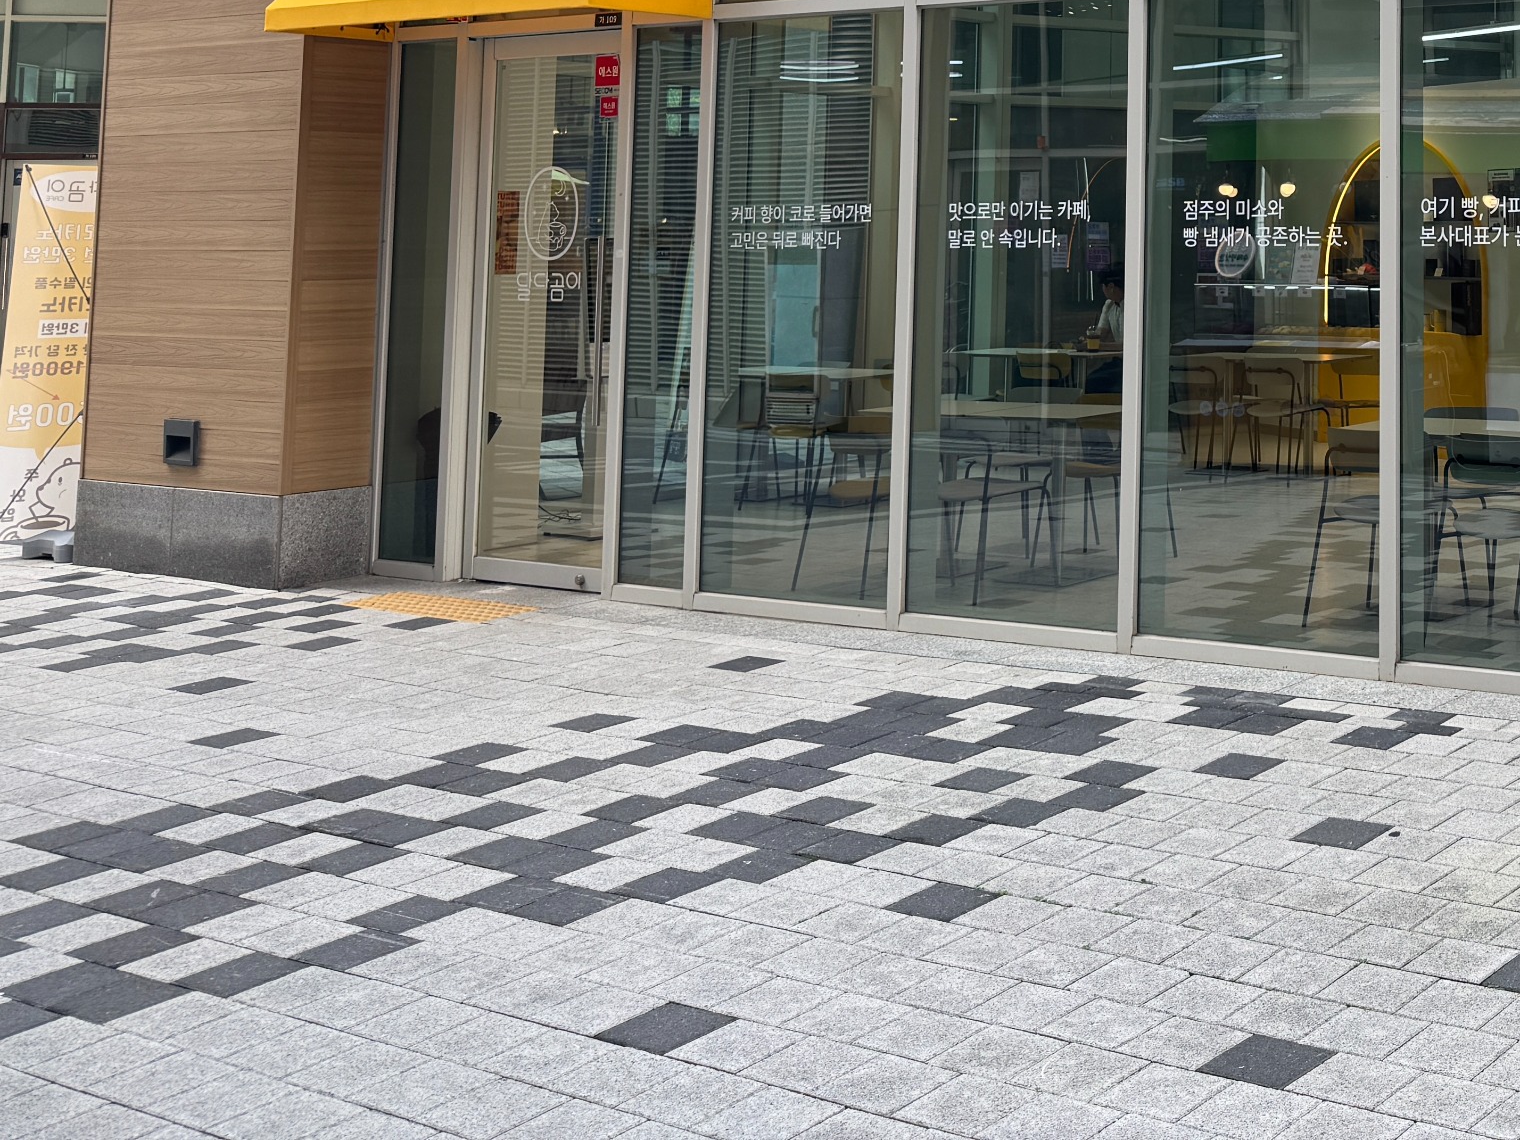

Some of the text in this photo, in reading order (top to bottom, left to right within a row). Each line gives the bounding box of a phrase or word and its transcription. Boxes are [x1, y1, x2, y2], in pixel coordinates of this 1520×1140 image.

[731, 202, 873, 225] 커피 향이 코로 들어가면
[948, 201, 1006, 222] 맛으로만
[1010, 200, 1054, 221] 이기는
[1183, 198, 1285, 221] 점주의 미소와
[1420, 196, 1456, 219] 여기
[1461, 195, 1484, 221] 빵,
[730, 230, 841, 250] 고민은 뒤로 빠진다
[947, 228, 1061, 249] 말로 안 속입니다.
[1183, 225, 1348, 248] 빵 냄새가 공존하는 곳.
[1419, 225, 1509, 248] 본사대표가
[516, 271, 581, 302] 달다곰이
